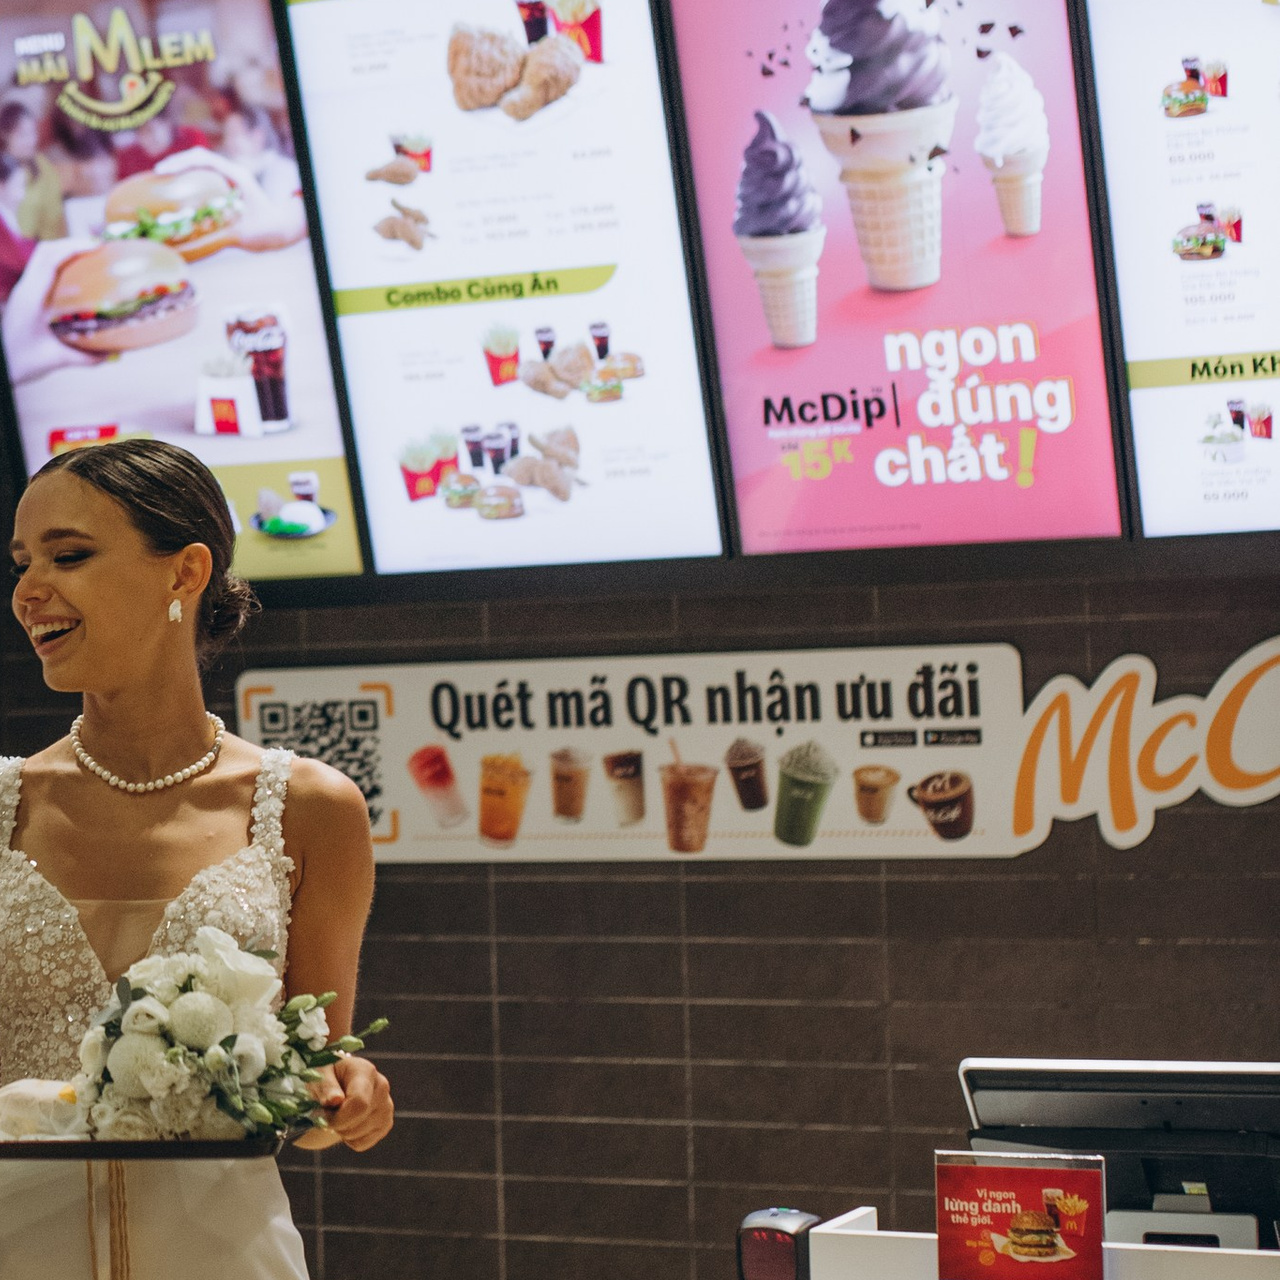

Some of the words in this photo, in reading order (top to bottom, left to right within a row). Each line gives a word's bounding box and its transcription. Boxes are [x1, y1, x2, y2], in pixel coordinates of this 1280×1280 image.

[385, 283, 462, 307] Combo
[531, 271, 559, 293] Ăn
[883, 322, 1039, 380] ngon
[1191, 355, 1245, 380] Món
[762, 389, 887, 429] McDip
[917, 374, 1074, 434] đúng
[431, 679, 535, 740] Quét
[547, 675, 613, 728] mã
[626, 675, 692, 736] QR
[706, 667, 822, 737] nhận
[835, 673, 894, 721] ưu
[907, 662, 981, 719] đãi
[982, 1199, 1021, 1214] danh
[989, 1190, 1016, 1201] ngon
